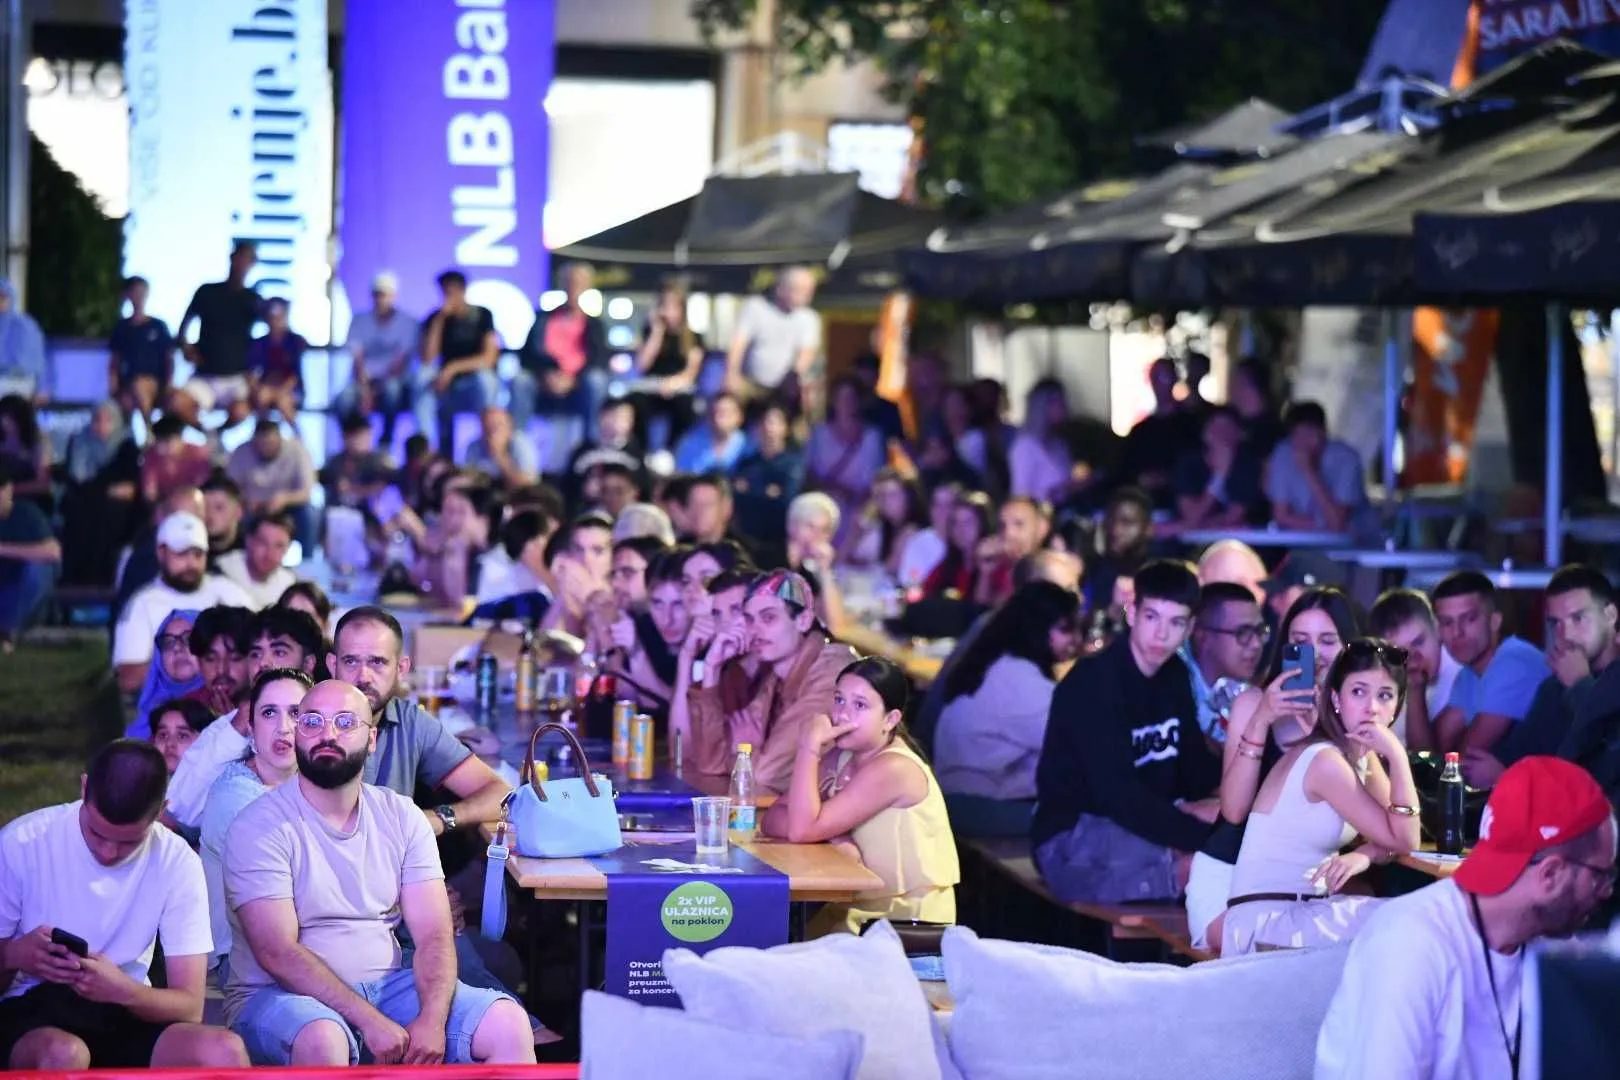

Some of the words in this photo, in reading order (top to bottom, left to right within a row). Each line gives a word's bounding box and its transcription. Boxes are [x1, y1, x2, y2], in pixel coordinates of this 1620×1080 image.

[139, 0, 160, 53] KLI
[446, 111, 520, 268] NLB
[678, 896, 692, 906] 2x
[695, 896, 717, 905] VIP
[664, 907, 728, 916] ULAZNICA
[688, 917, 724, 926] poklon
[629, 961, 661, 969] Otvori
